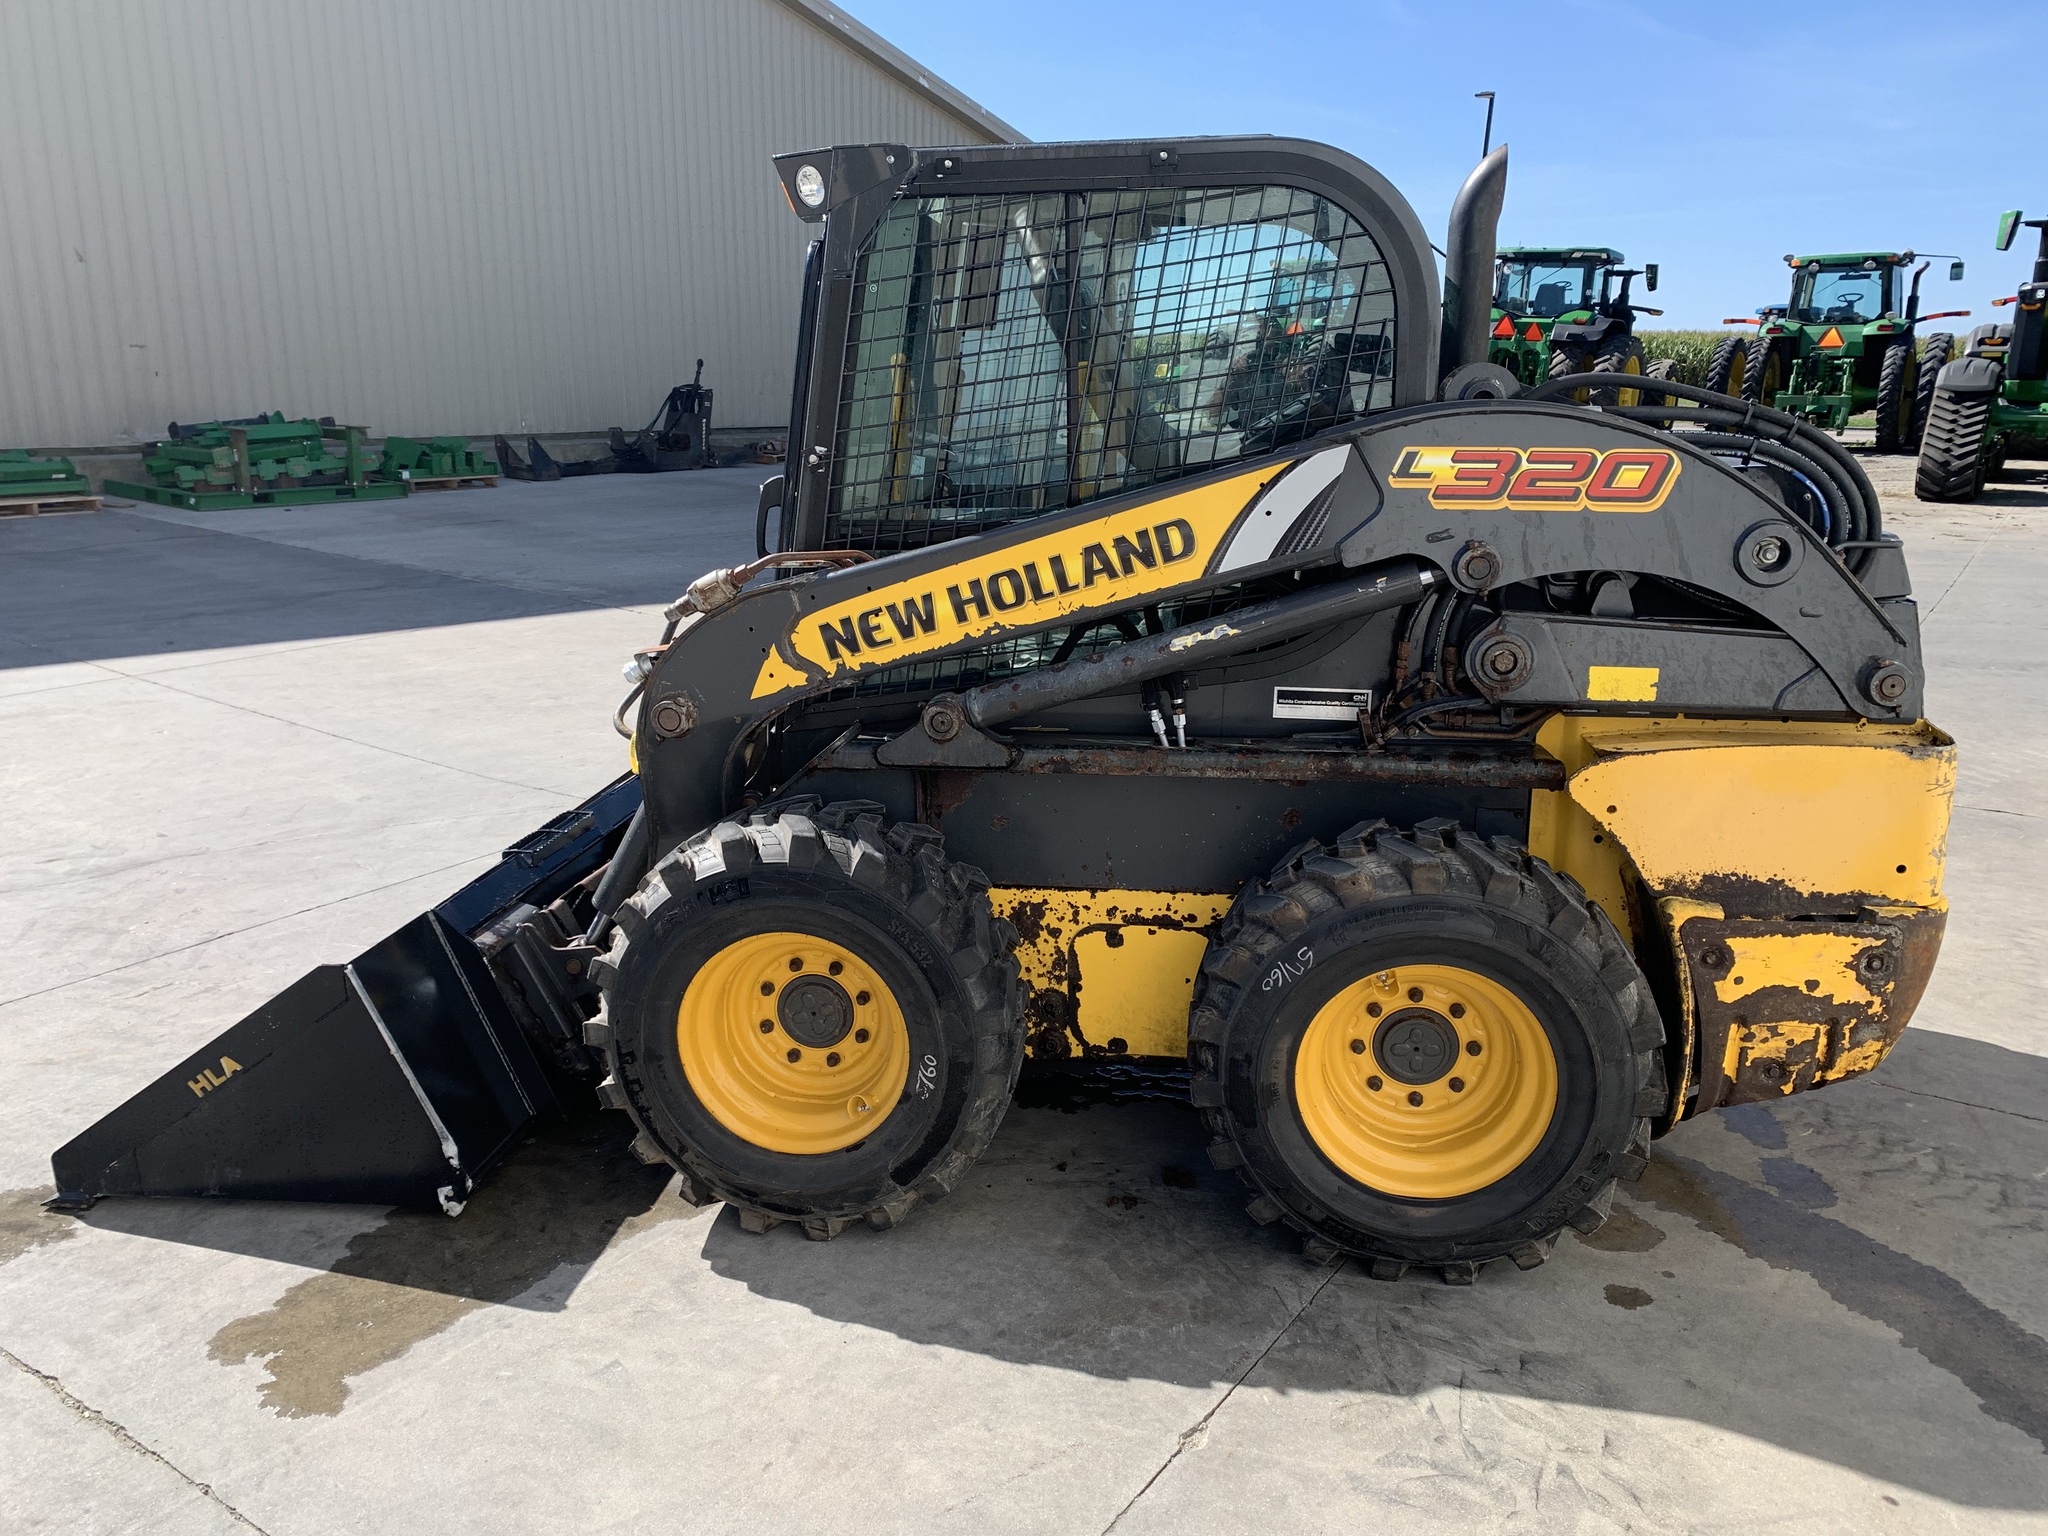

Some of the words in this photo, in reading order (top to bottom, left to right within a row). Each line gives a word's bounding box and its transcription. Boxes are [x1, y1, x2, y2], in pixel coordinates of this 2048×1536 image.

[818, 591, 939, 663] NEW
[946, 518, 1197, 625] HOLLAND
[187, 1055, 244, 1098] HLA
